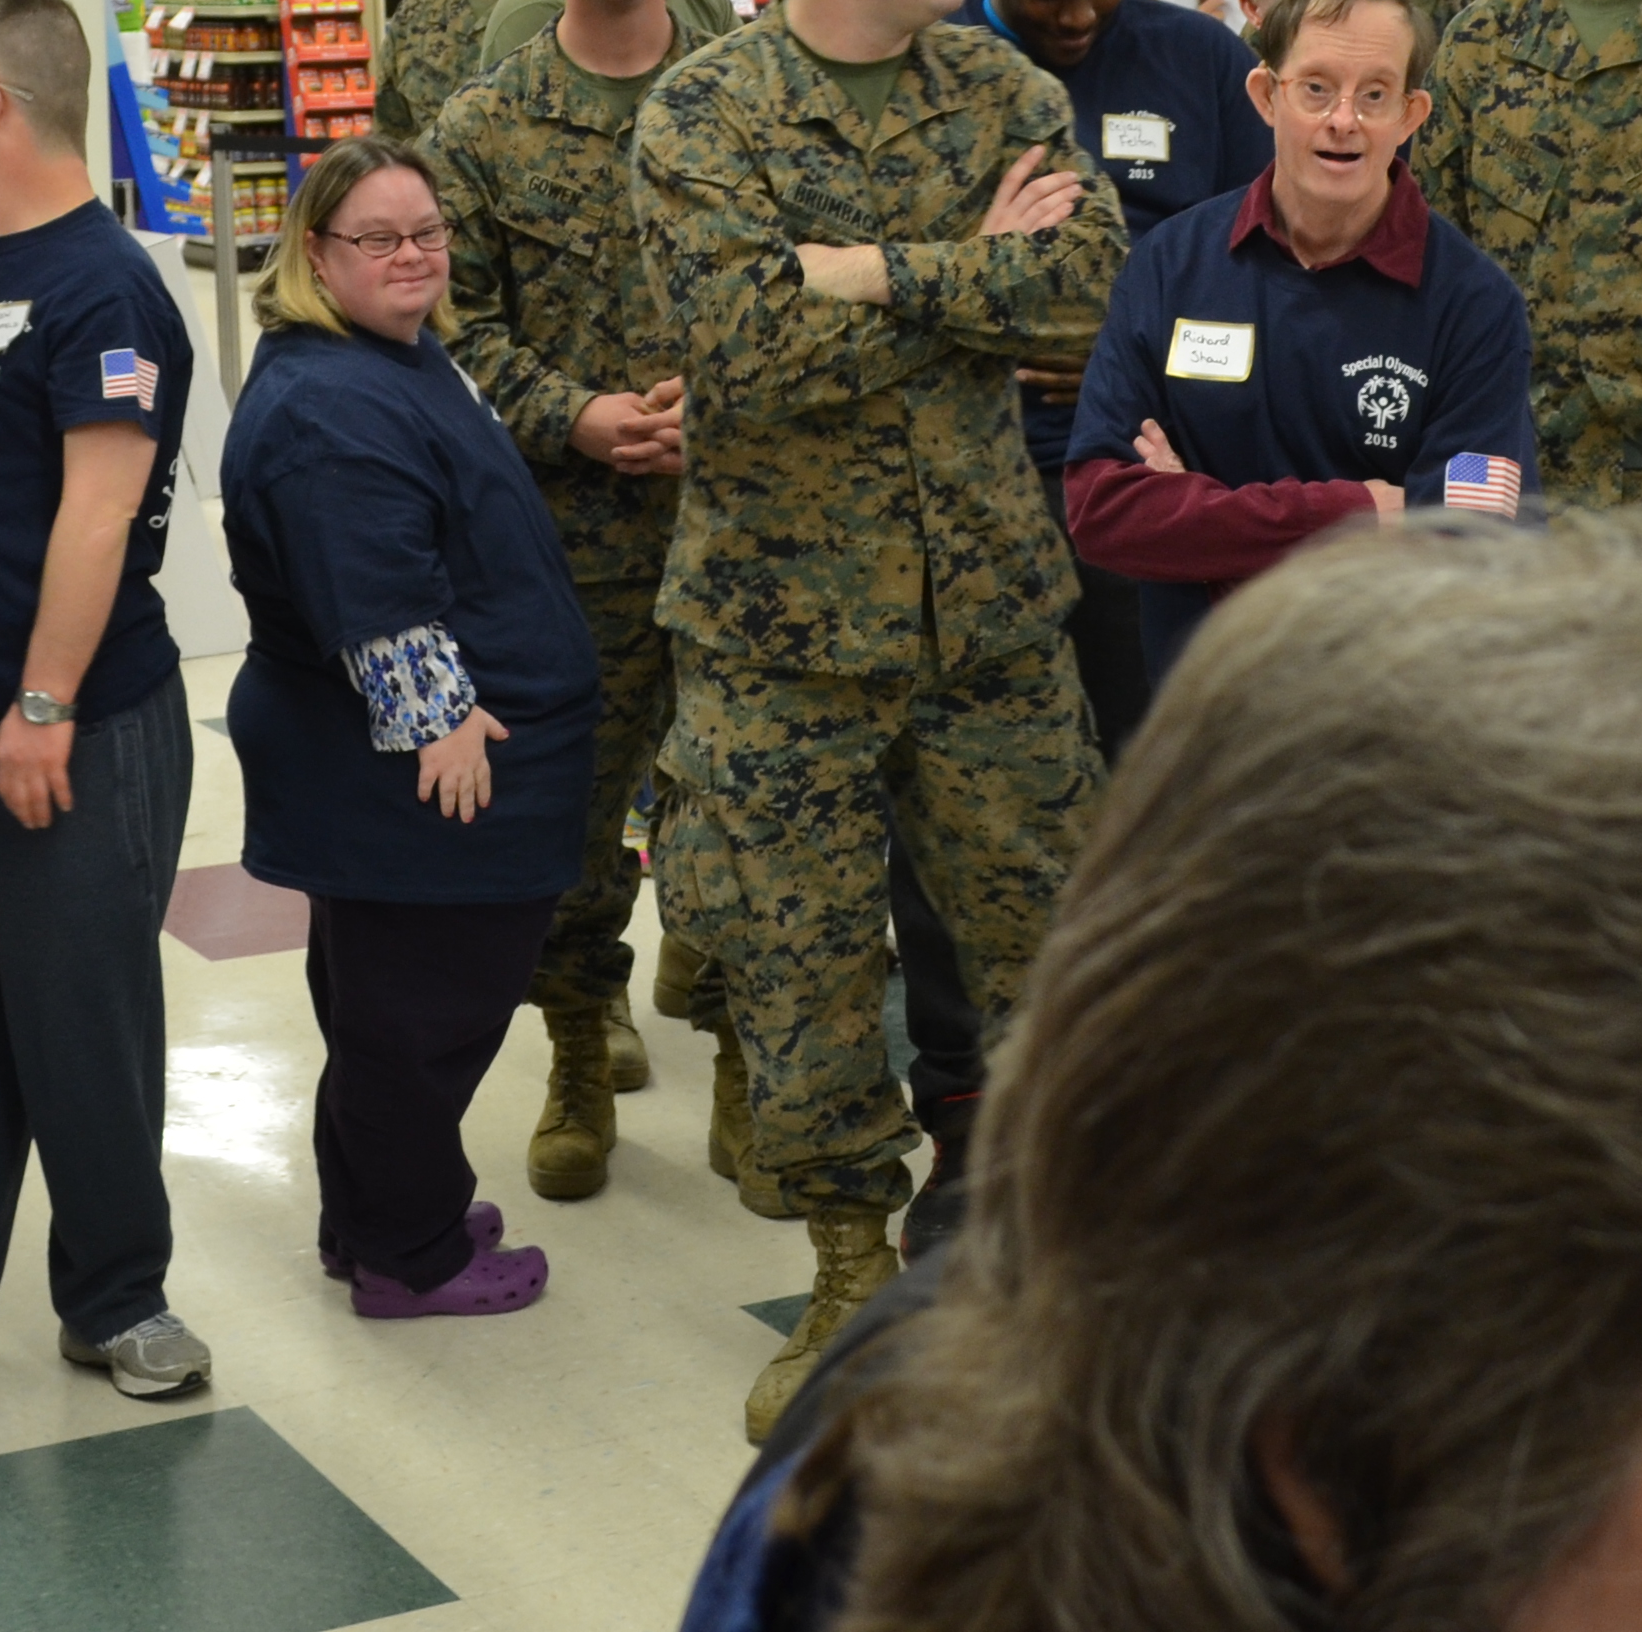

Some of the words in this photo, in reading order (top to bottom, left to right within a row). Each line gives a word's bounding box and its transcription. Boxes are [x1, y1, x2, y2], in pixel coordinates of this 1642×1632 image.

[1128, 168, 1155, 180] 2015
[528, 175, 583, 207] GOWEN
[1183, 330, 1230, 346] Richard
[1190, 350, 1228, 366] Shaw
[1341, 354, 1383, 377] Special
[1364, 432, 1398, 449] 2015
